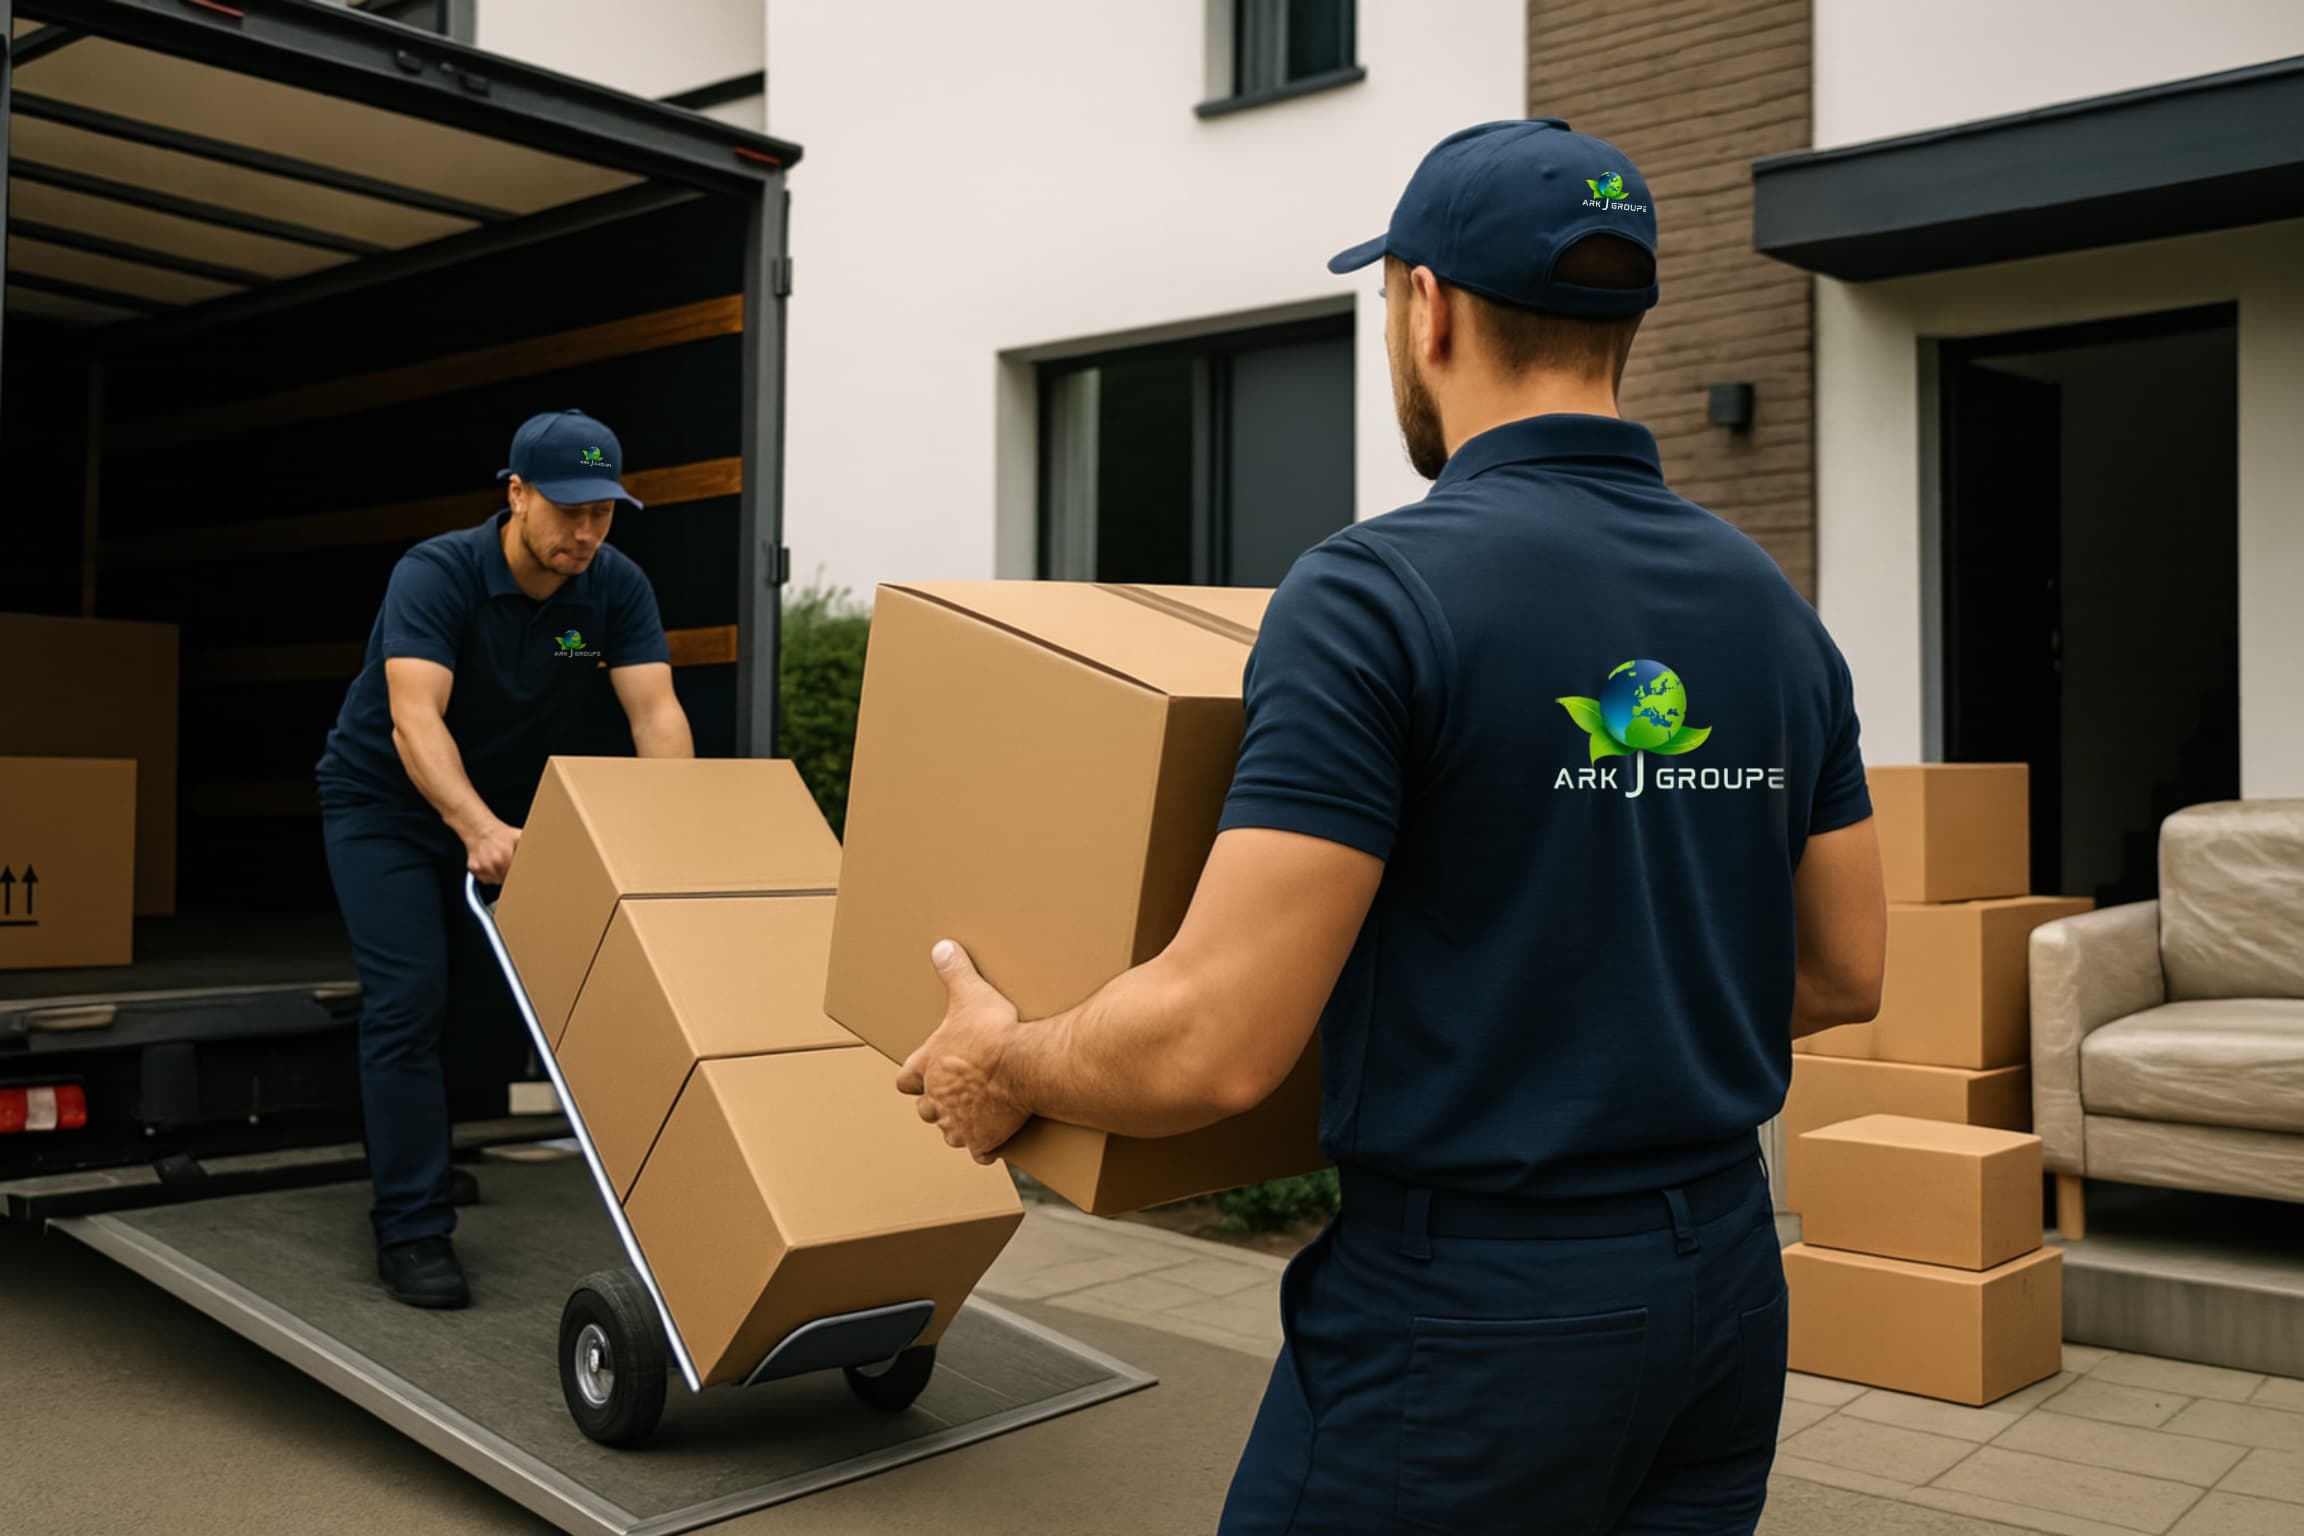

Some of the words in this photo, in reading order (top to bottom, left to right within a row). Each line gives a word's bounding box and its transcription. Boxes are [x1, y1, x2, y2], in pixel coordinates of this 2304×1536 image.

[1582, 199, 1601, 208] ARK
[1602, 197, 1610, 211] J
[1611, 202, 1647, 213] GROUPE
[1553, 767, 1618, 790] ARK
[1625, 750, 1645, 798] J
[1655, 767, 1785, 790] GROUPE
